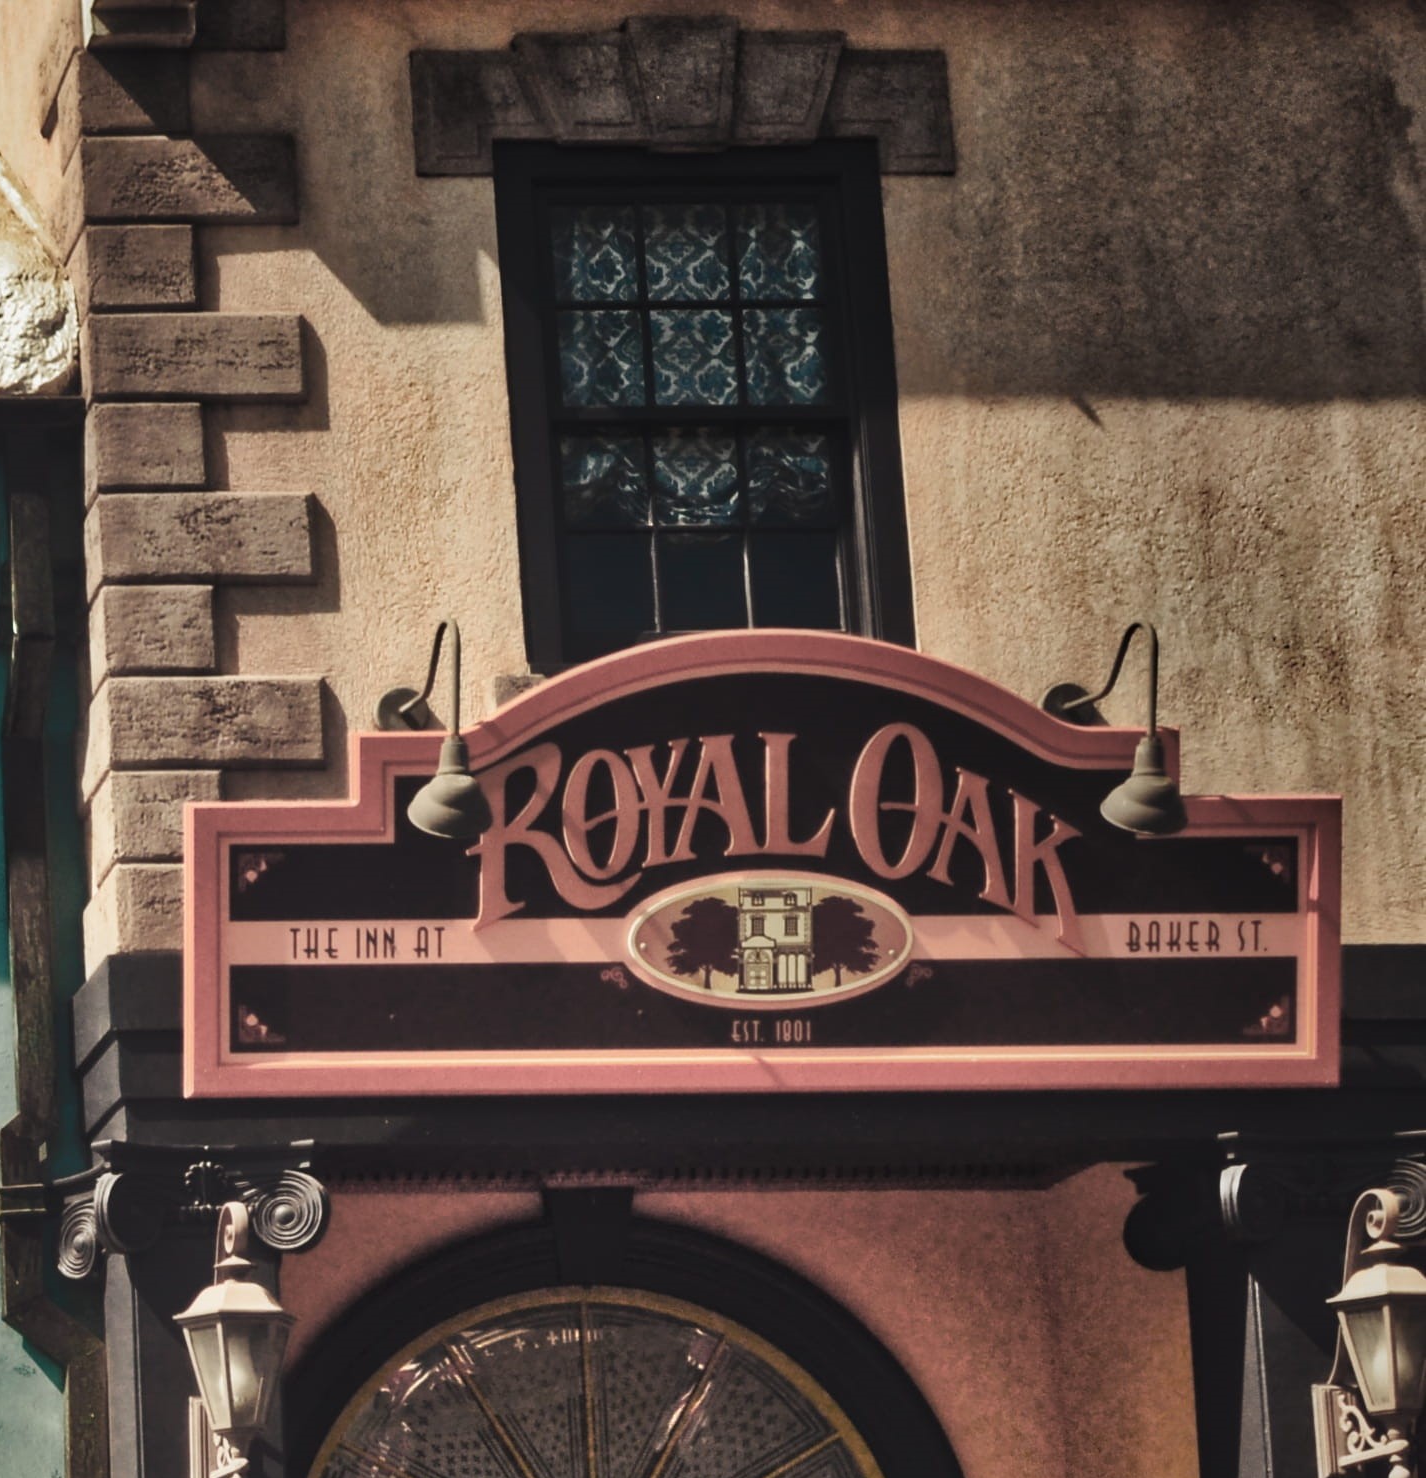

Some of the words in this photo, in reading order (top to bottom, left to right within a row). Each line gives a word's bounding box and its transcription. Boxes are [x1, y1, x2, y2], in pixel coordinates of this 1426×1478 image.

[466, 732, 836, 931] ROYAL
[849, 722, 1086, 957] OAK
[290, 927, 338, 959] THE
[356, 927, 396, 959] INN
[414, 926, 445, 958] AT
[1126, 920, 1220, 952] BAKER
[1237, 920, 1268, 952] ST.
[731, 1019, 764, 1042] EST.
[775, 1019, 811, 1042] 1801
